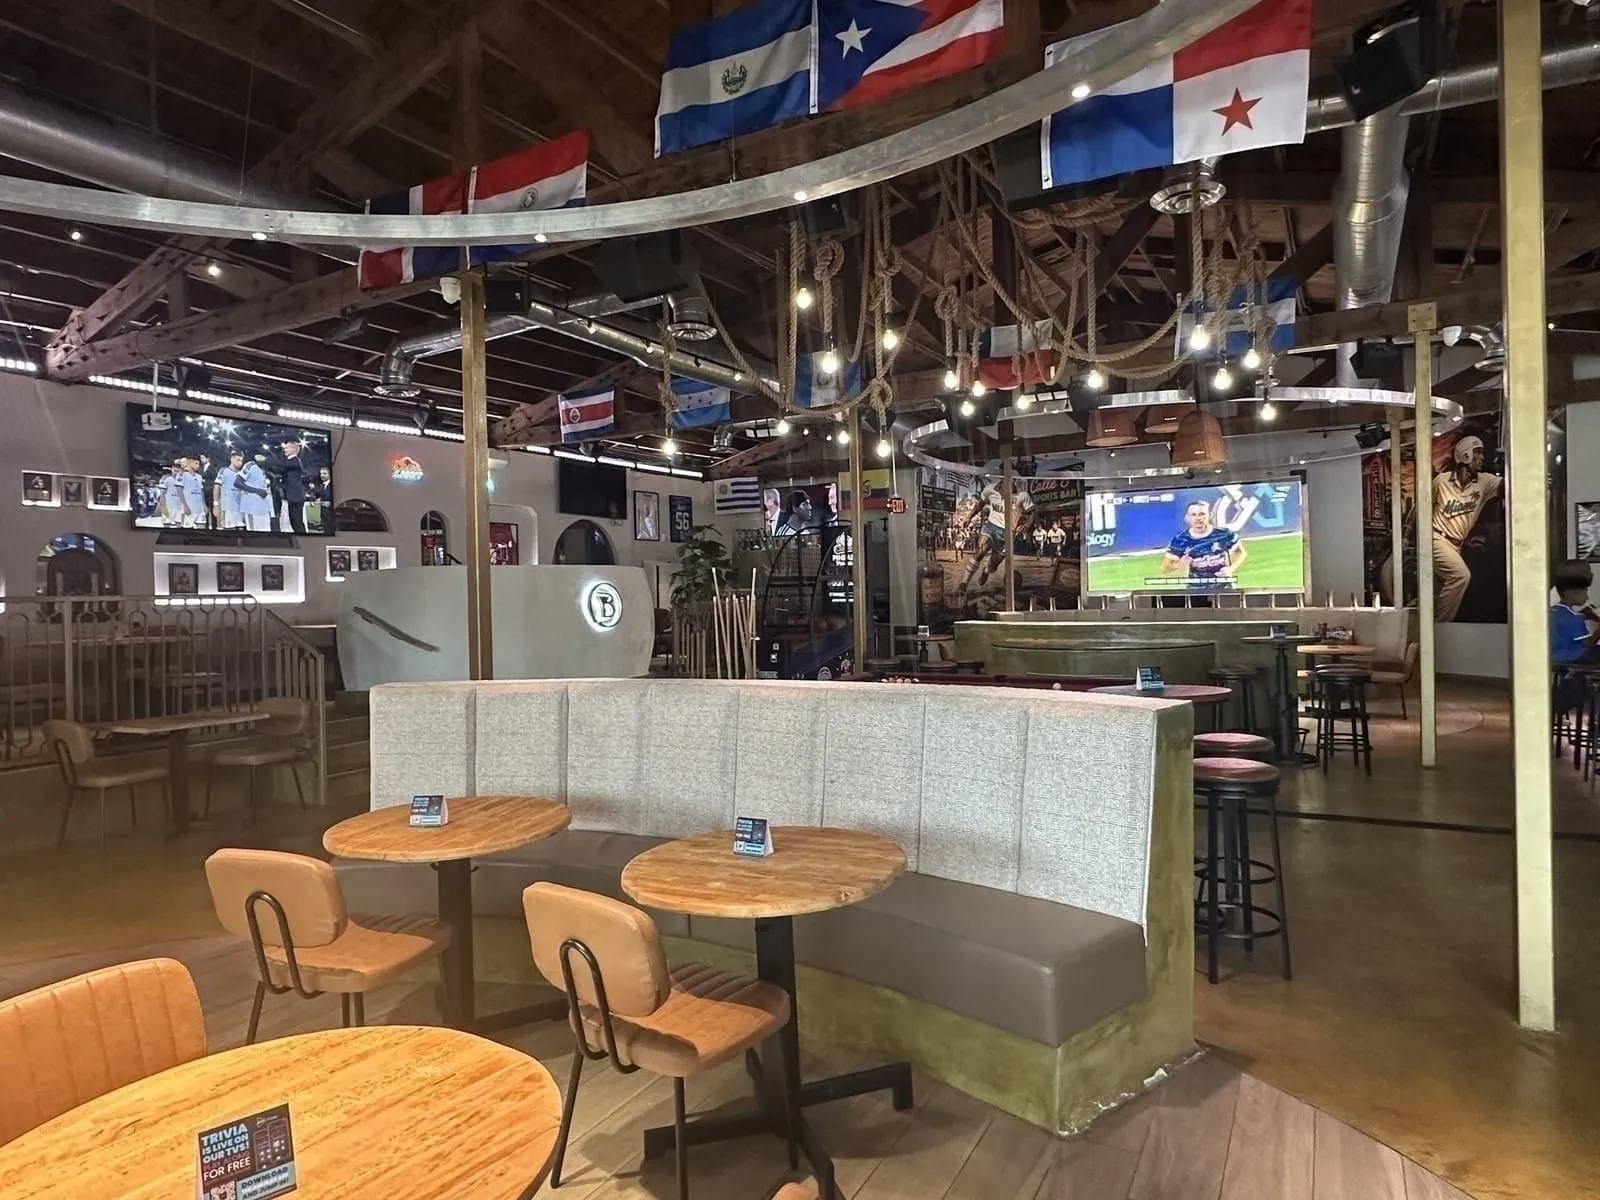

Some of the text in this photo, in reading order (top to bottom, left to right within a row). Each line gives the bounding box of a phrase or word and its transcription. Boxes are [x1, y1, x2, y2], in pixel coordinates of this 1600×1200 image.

[1060, 488, 1077, 499] BAR
[892, 499, 904, 512] EXIT
[1443, 499, 1477, 515] Miami
[675, 512, 690, 530] 56
[201, 1123, 248, 1147] TRIVIA
[202, 1132, 249, 1156] IS LIVE ON
[203, 1141, 250, 1164] OUR TVS!
[203, 1164, 225, 1182] FOR
[227, 1156, 251, 1173] FREE
[241, 1166, 289, 1188] DOWNLOAD
